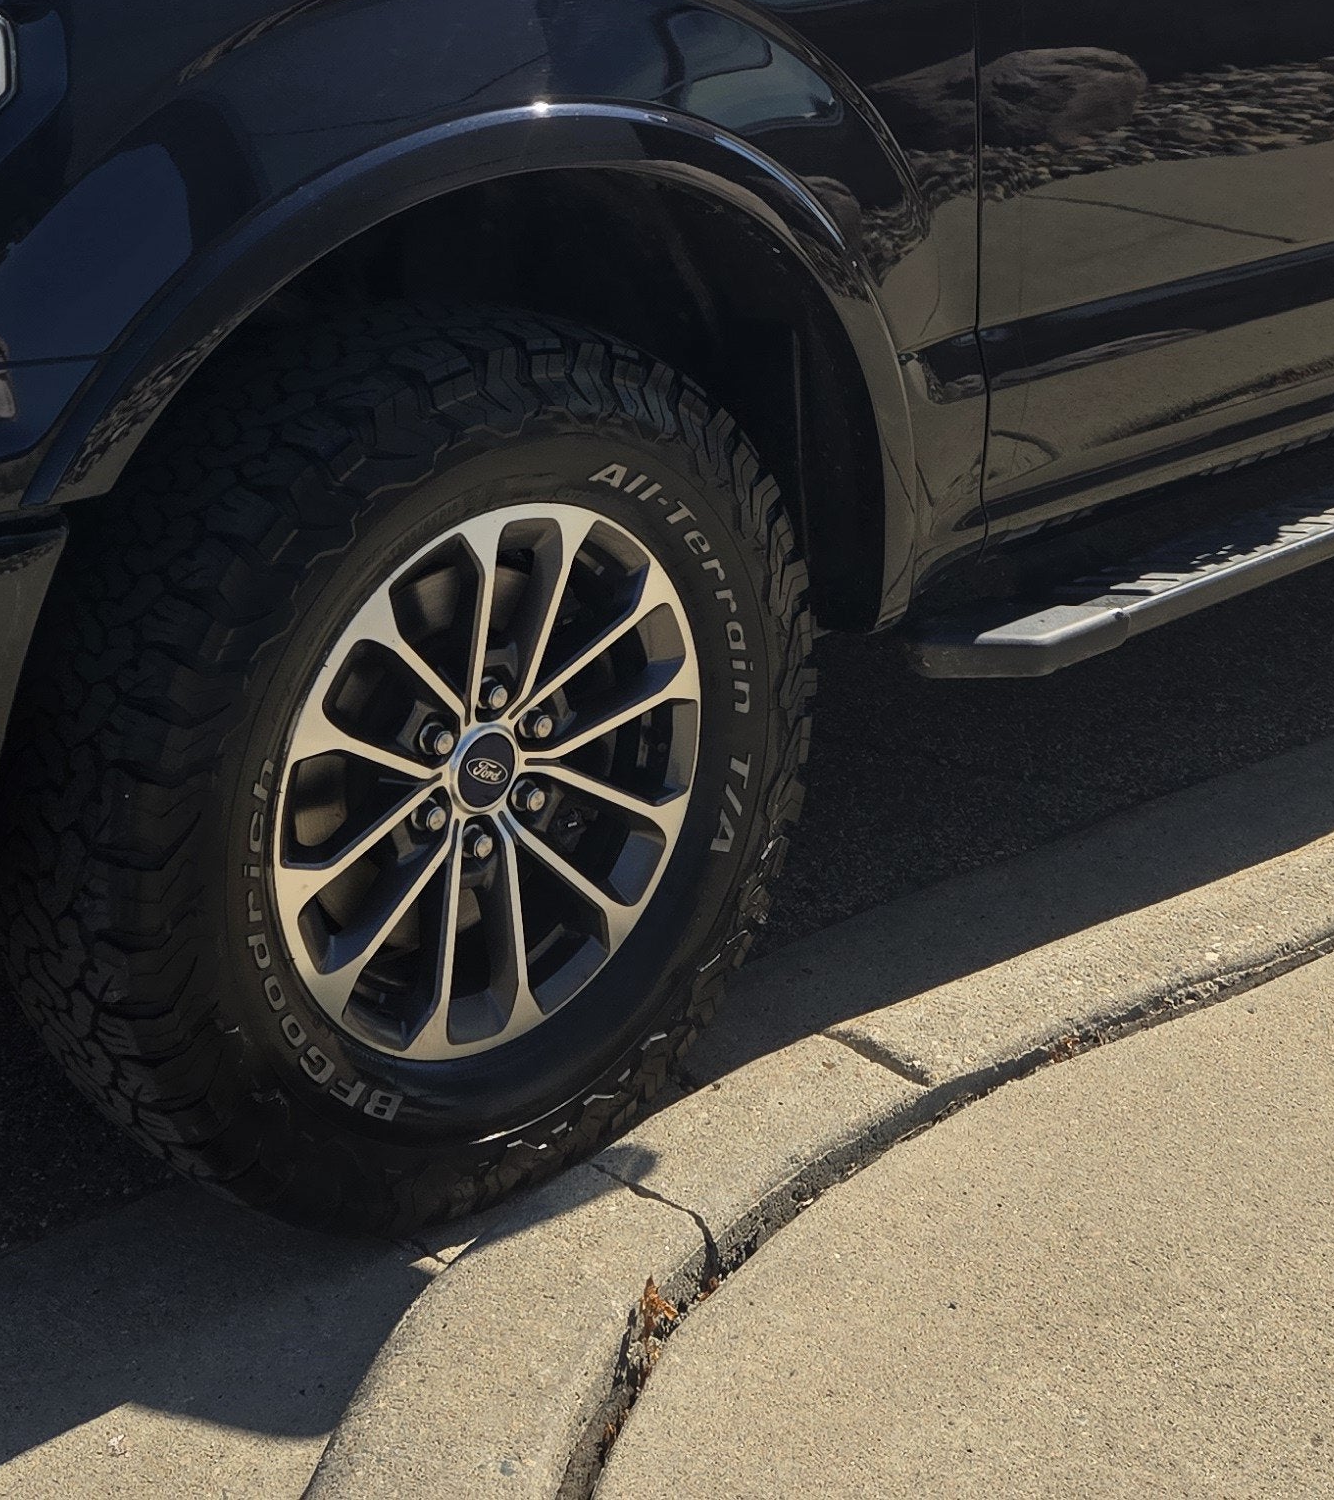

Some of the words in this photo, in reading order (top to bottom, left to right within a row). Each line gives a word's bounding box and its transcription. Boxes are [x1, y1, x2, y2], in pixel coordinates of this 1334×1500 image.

[472, 760, 503, 781] Ford
[588, 462, 755, 716] All-Terrain
[709, 752, 753, 854] T/A
[241, 758, 405, 1122] BFGoodrich
